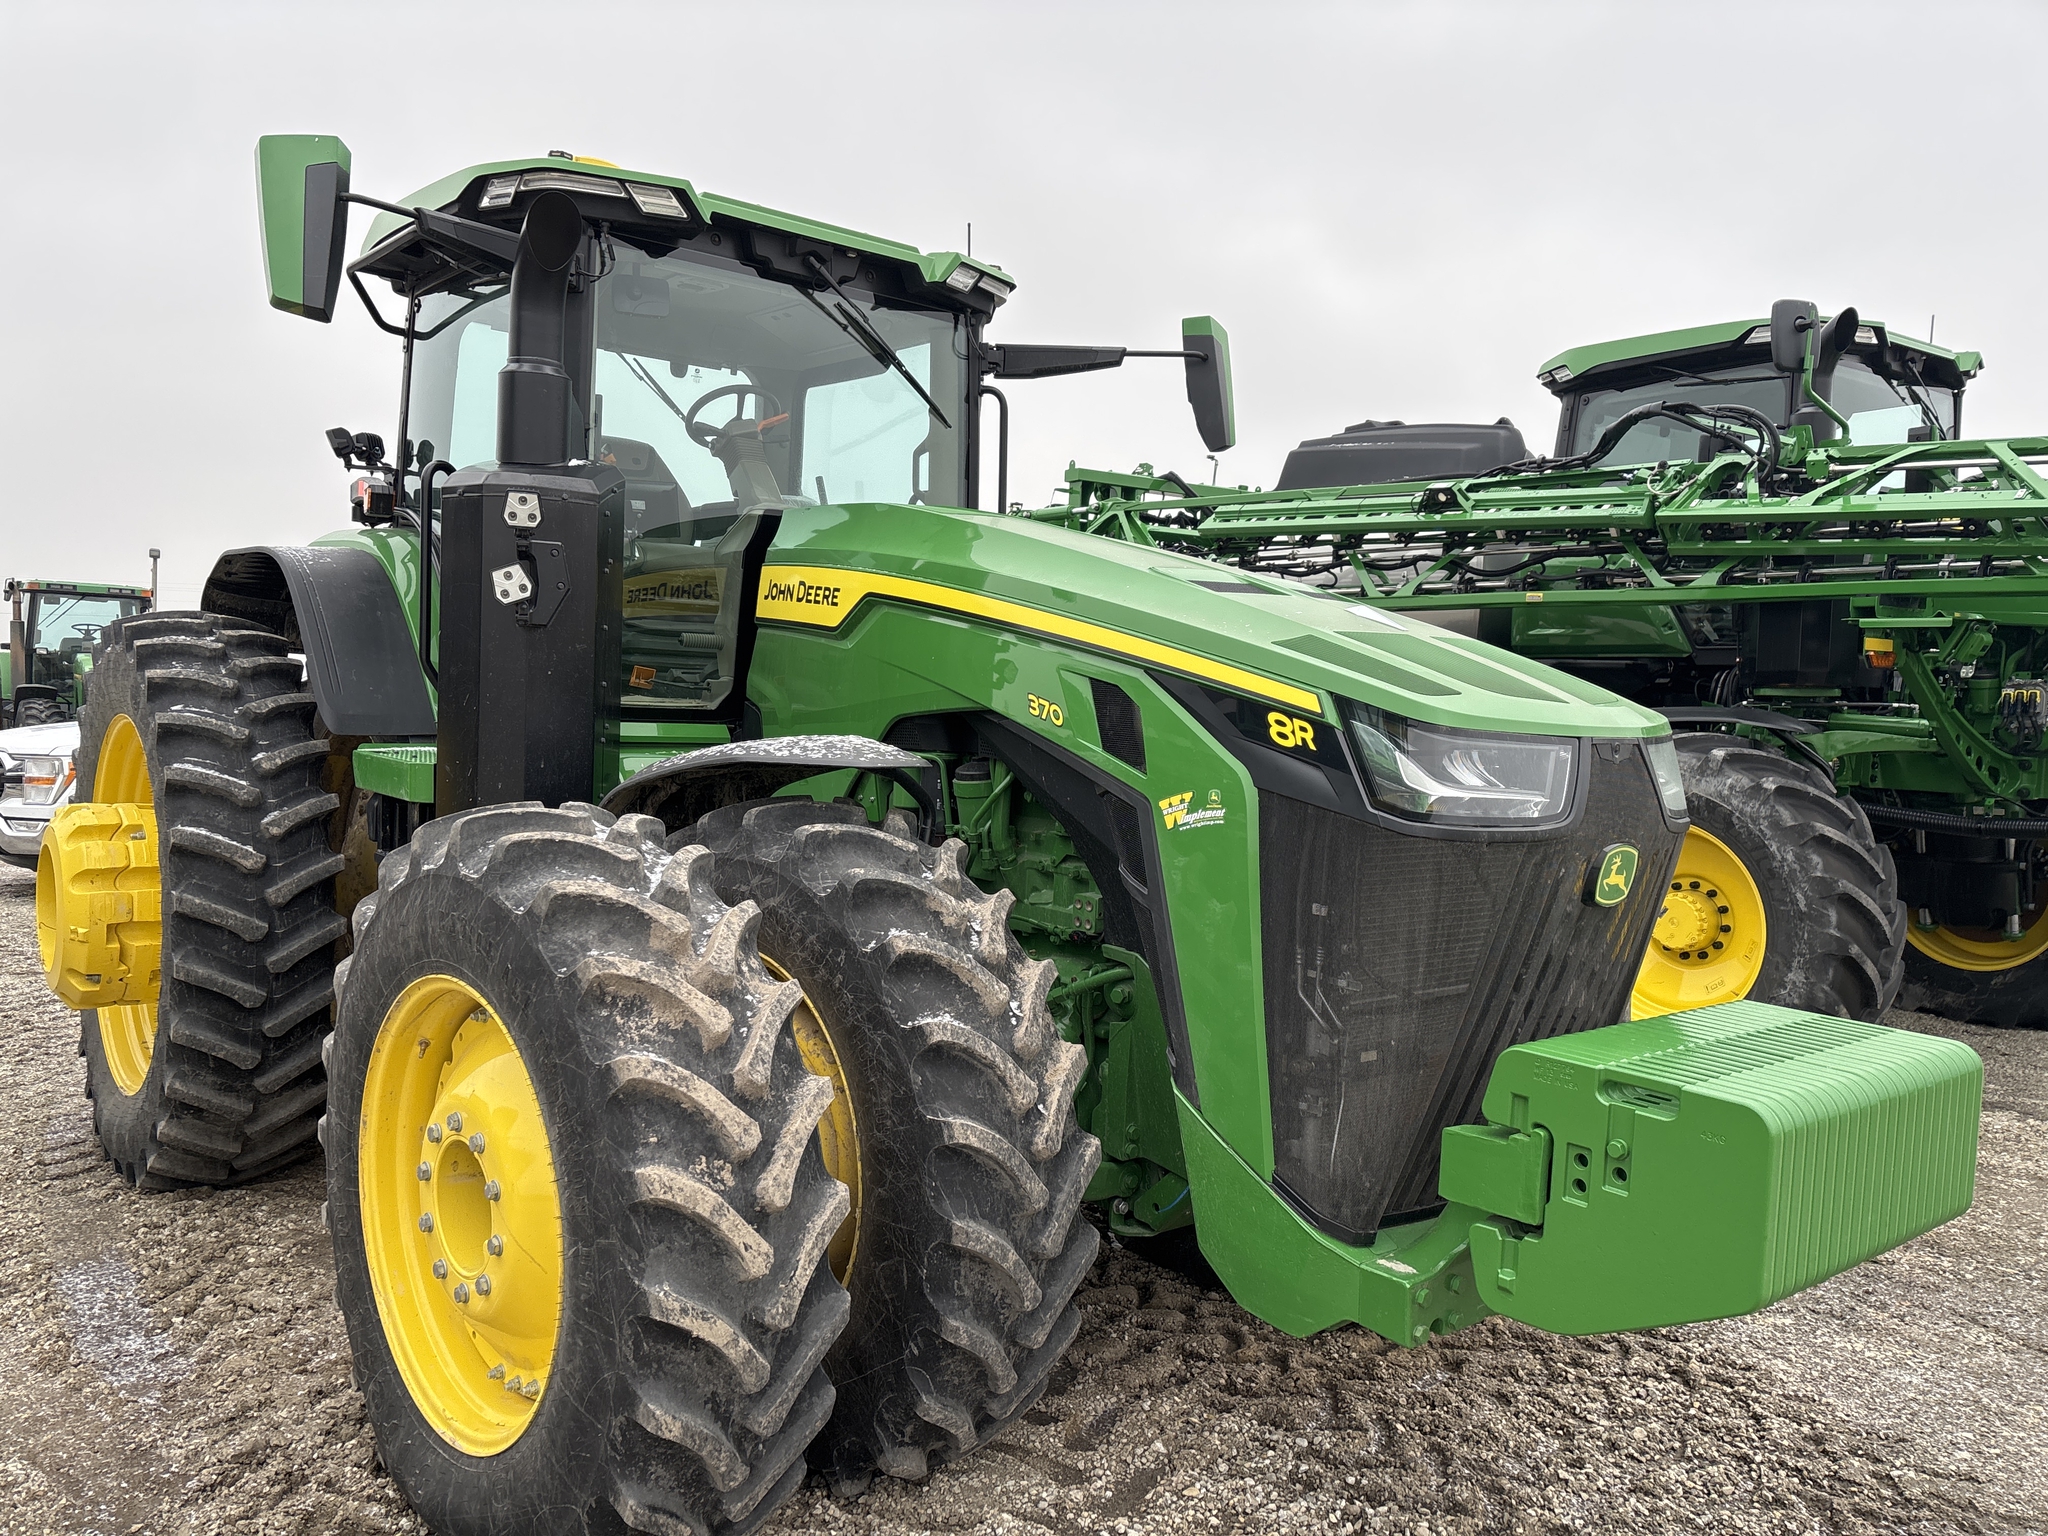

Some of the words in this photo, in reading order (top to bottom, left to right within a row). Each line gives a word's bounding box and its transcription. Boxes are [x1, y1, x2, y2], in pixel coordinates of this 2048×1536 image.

[764, 579, 795, 602] JOHN
[796, 581, 841, 607] DEERE
[1027, 692, 1065, 728] 370
[1267, 711, 1317, 751] 8R
[1181, 808, 1226, 825] Implement
